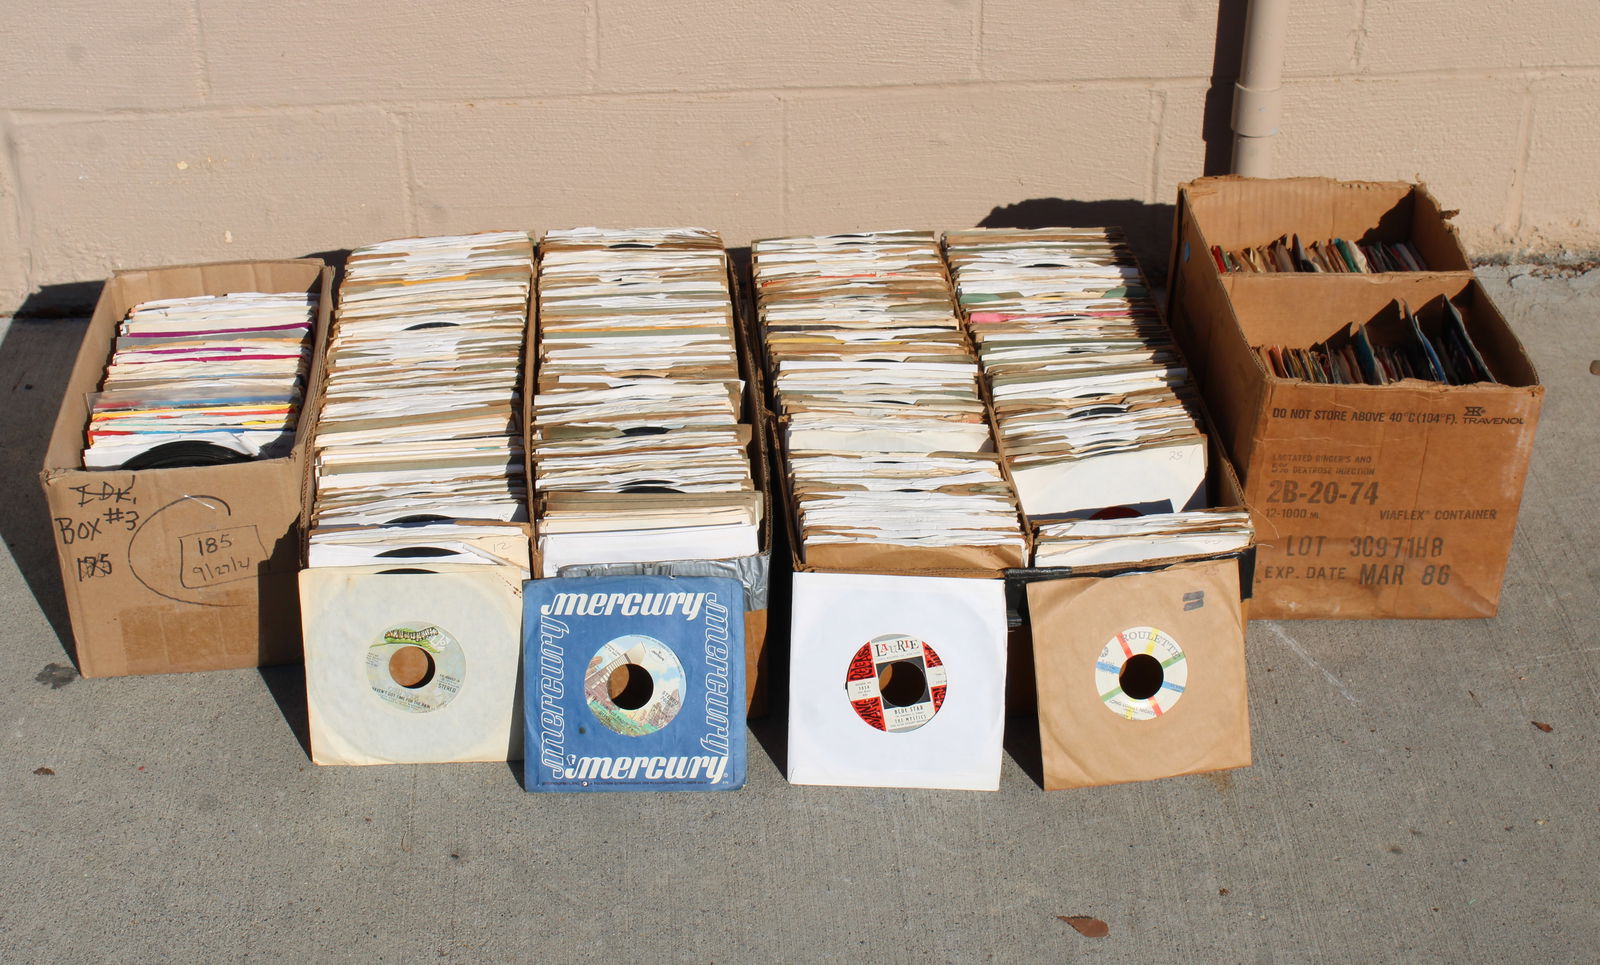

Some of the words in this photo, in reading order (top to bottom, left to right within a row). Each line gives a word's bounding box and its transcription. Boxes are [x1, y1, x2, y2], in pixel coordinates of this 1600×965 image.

[1272, 408, 1287, 418] DO
[1290, 409, 1312, 419] NOT
[1314, 410, 1347, 421] STORE
[1351, 411, 1385, 422] ABOVE
[1462, 417, 1524, 425] TRAVENOL
[1266, 480, 1380, 505] 2B-20-74
[55, 517, 102, 544] BOX
[103, 507, 140, 531] #3
[1434, 509, 1497, 520] CONTAINER
[198, 534, 233, 556] 185
[1286, 536, 1327, 557] LOT
[1264, 566, 1299, 579] EXP.
[1306, 567, 1346, 580] DATE
[1359, 564, 1405, 585] MAR
[1421, 564, 1451, 586] 86
[541, 592, 704, 621] mercury
[1120, 630, 1181, 661] ROULETTE
[700, 592, 729, 758] mercury
[541, 615, 569, 780] mercury
[564, 755, 729, 784] mercury
